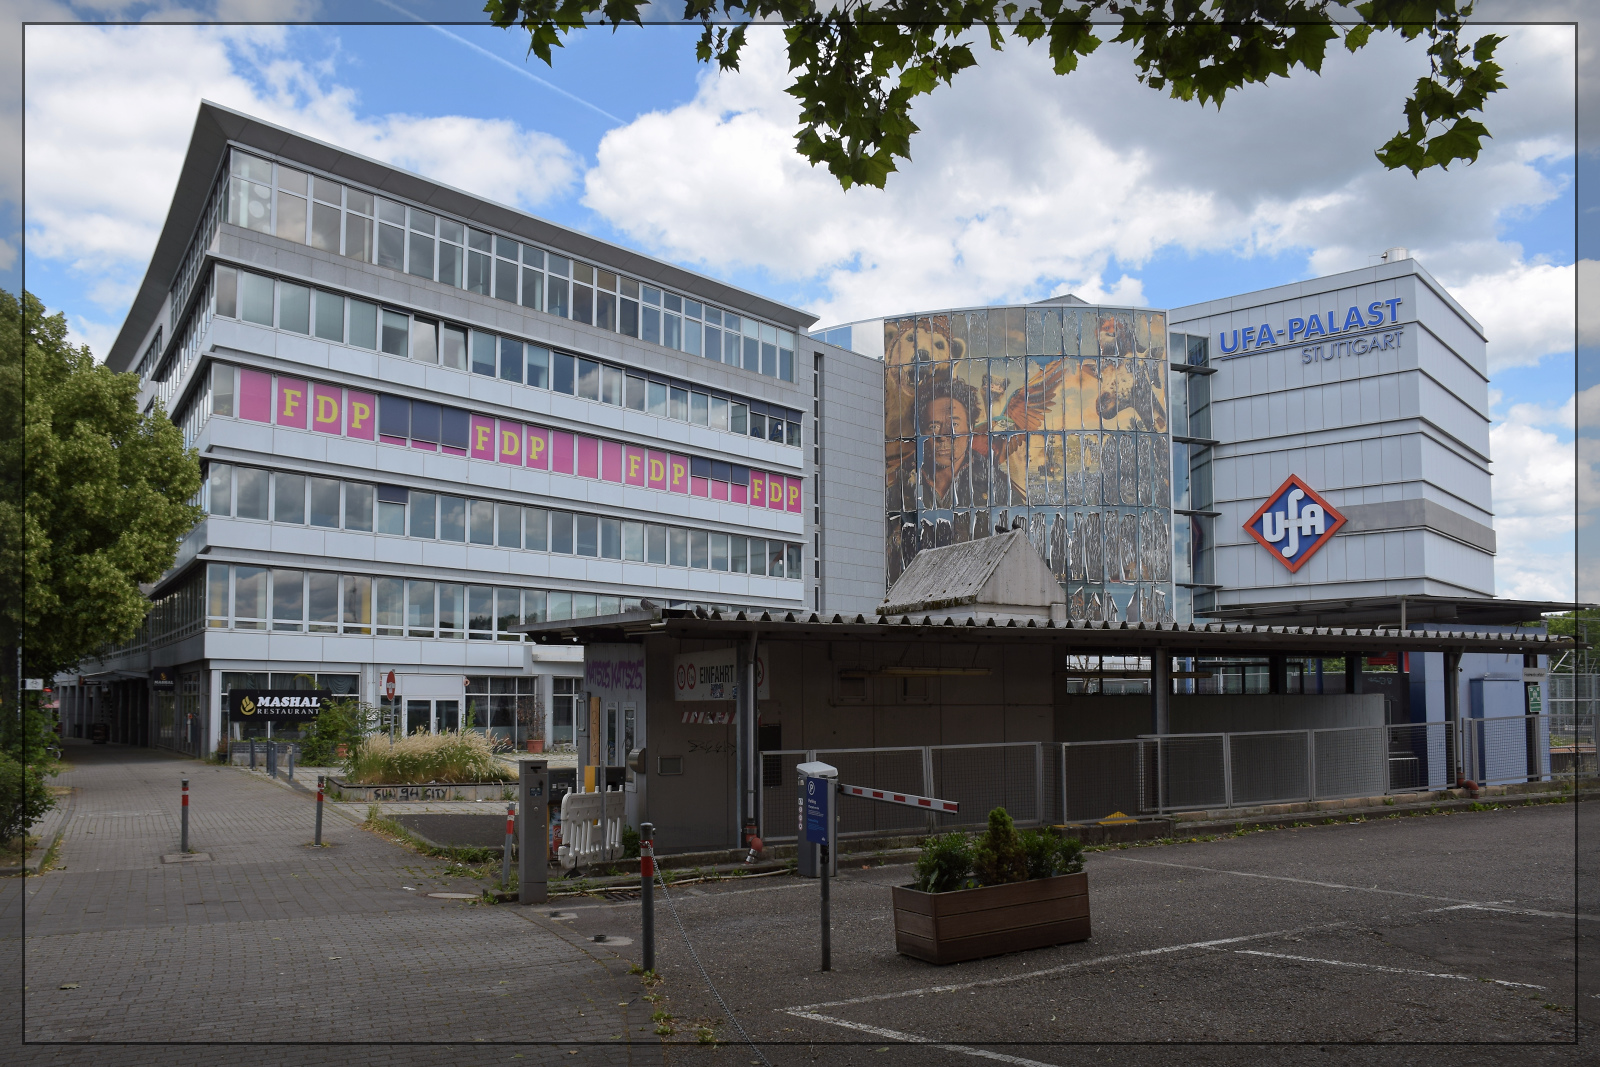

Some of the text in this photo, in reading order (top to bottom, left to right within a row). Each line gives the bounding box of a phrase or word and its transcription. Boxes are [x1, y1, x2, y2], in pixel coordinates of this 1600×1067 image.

[1220, 297, 1402, 353] UFA-PALAST
[1301, 331, 1402, 364] STUTTGART
[283, 388, 370, 429] FDP
[475, 425, 545, 460] FDP
[628, 454, 685, 485] FDP
[752, 479, 799, 506] FDP
[699, 665, 735, 684] EINFAHRT
[257, 696, 321, 707] MASHAL
